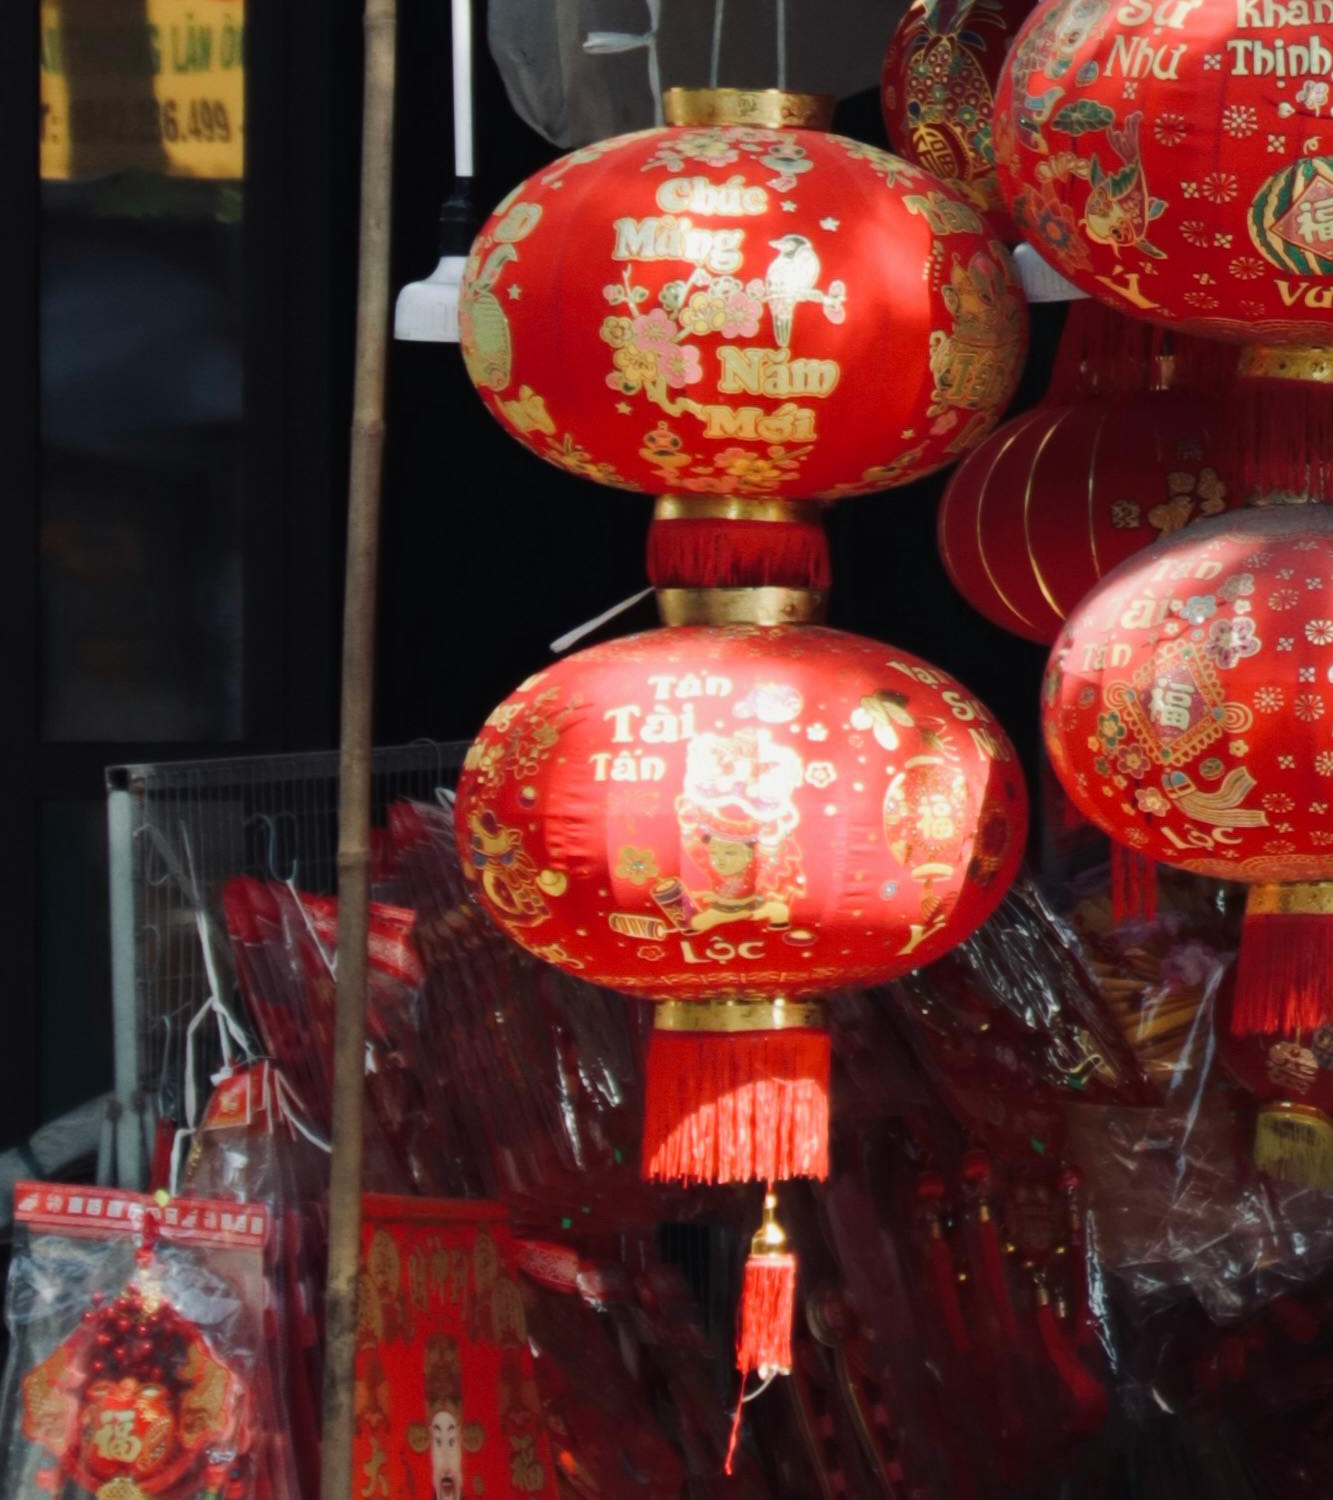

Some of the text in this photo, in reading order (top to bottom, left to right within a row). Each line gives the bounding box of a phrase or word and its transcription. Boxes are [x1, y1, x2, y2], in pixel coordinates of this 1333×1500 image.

[1103, 34, 1188, 81] Như
[1227, 35, 1333, 88] Thịnh
[656, 175, 768, 217] Chúc
[612, 215, 745, 273] Mừng
[716, 346, 840, 398] Năm
[702, 403, 817, 443] Mới
[603, 702, 698, 744] Tài
[1149, 677, 1196, 731] 福
[916, 793, 955, 841] 福
[94, 1408, 142, 1463] 福
